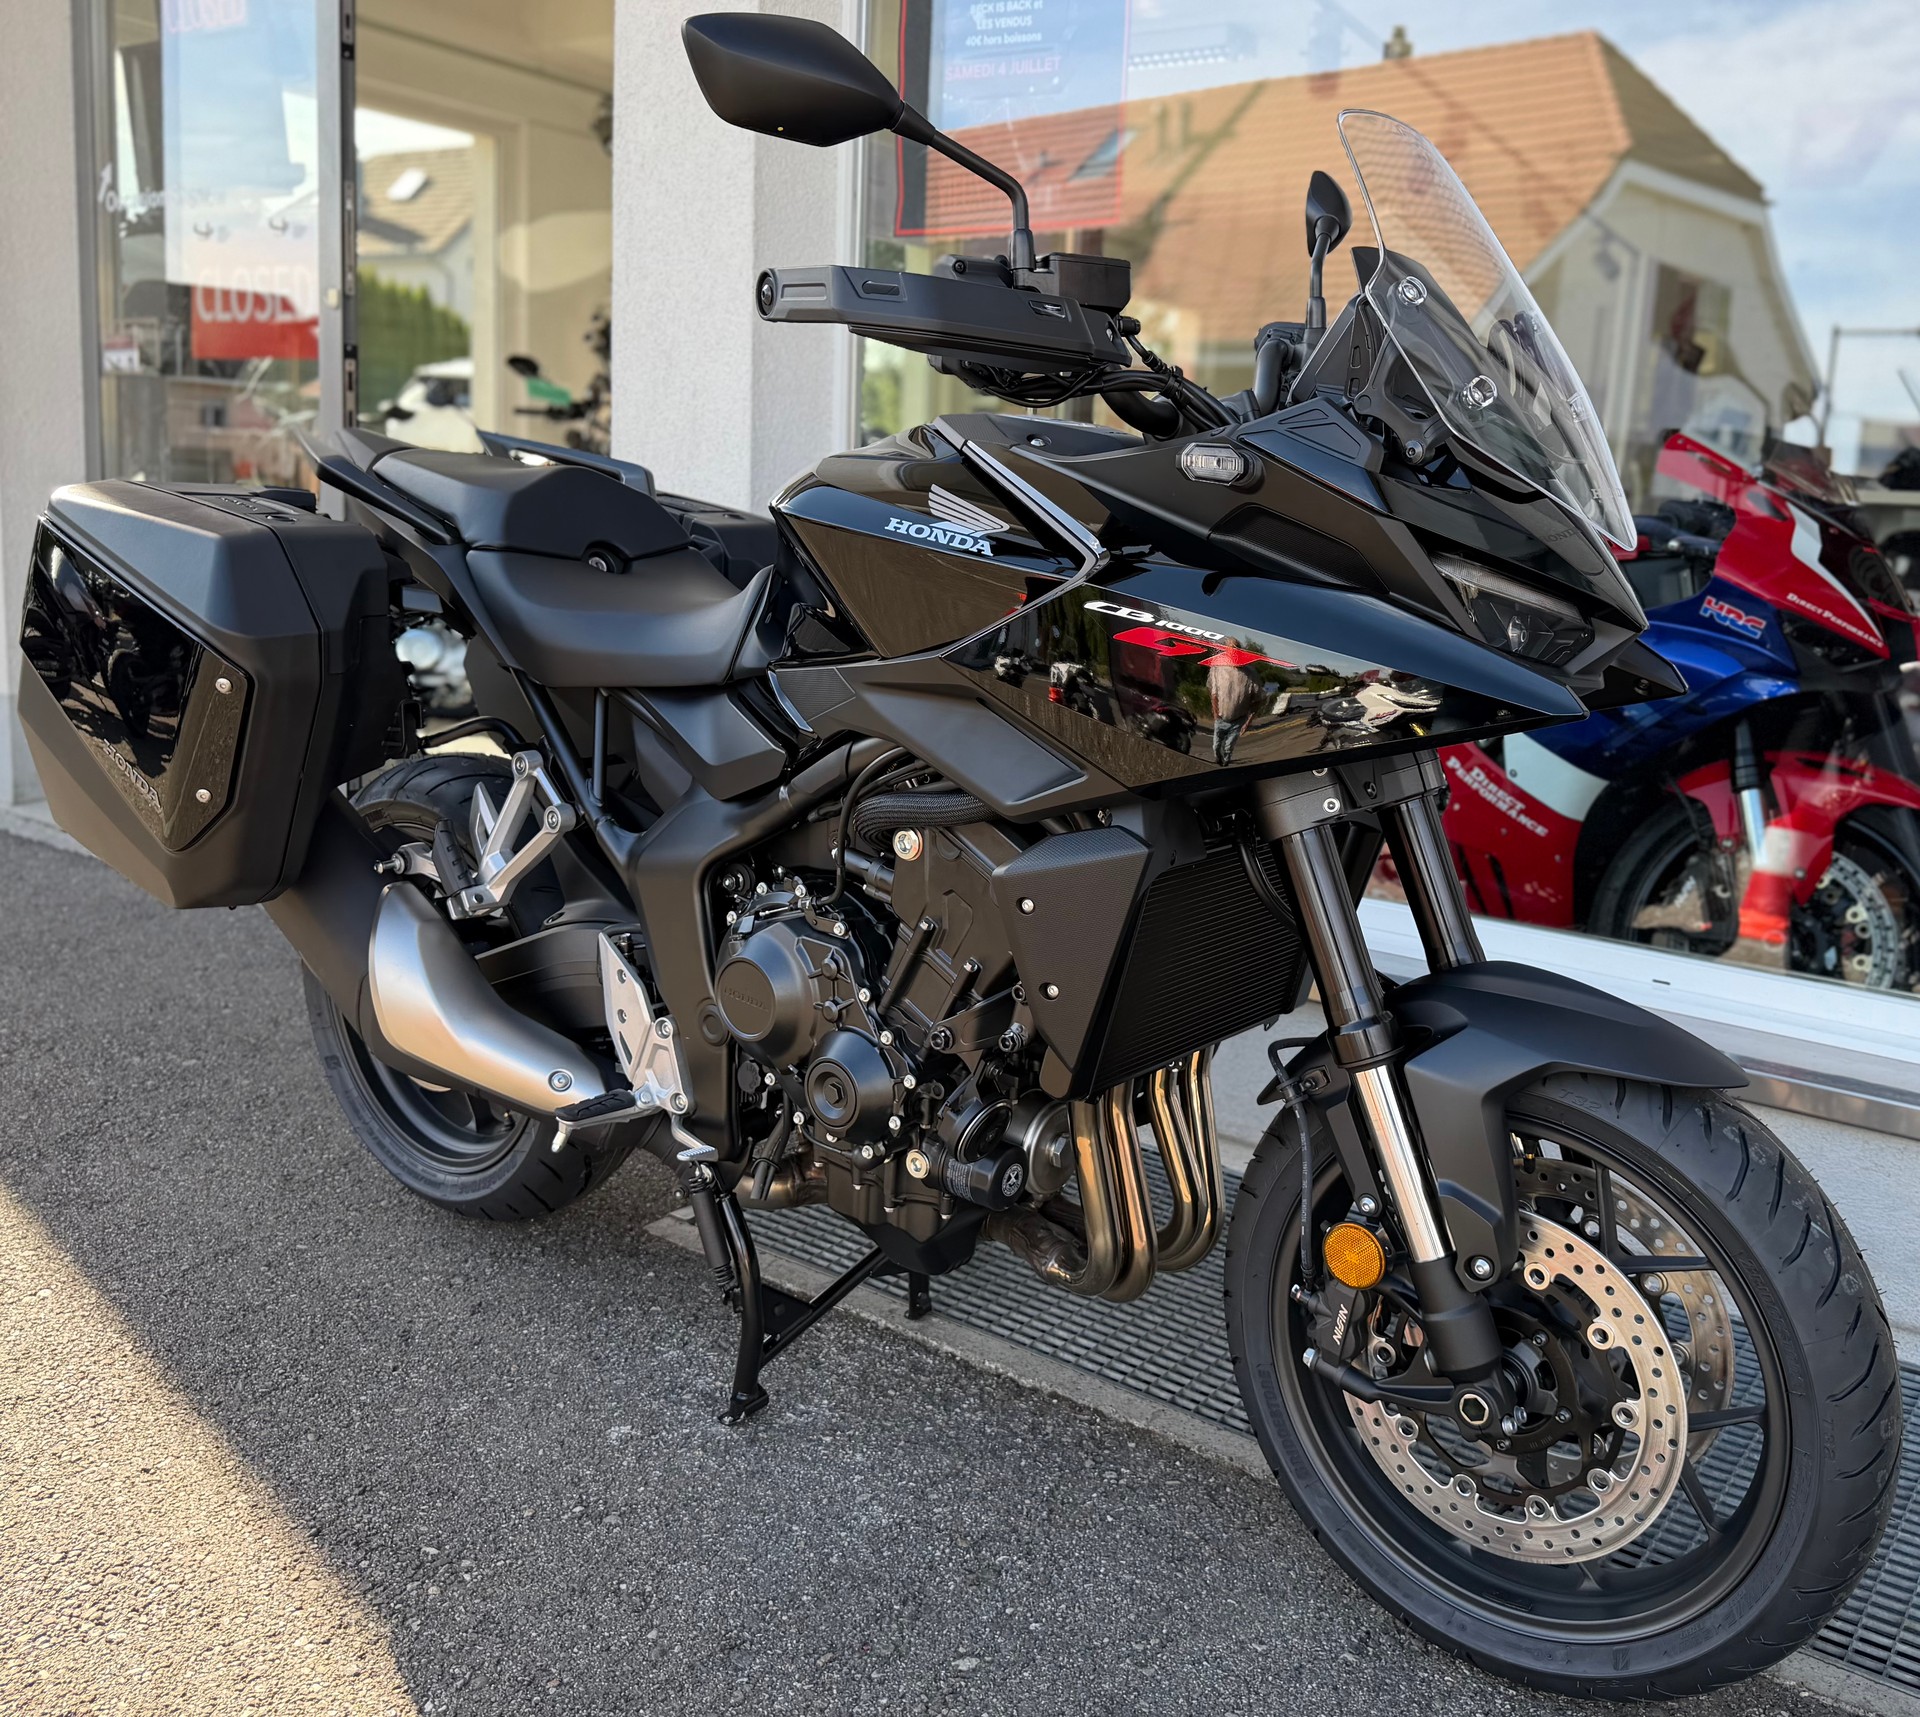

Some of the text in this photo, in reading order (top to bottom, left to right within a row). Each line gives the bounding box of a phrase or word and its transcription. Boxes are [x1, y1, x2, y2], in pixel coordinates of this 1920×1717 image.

[983, 34, 1002, 46] hors
[1004, 31, 1042, 44] boissons
[994, 15, 1032, 28] VENDUS
[945, 56, 1062, 82] SAMEDI 4 JUILLET
[196, 267, 312, 323] CLOSED
[884, 517, 994, 557] HONDA
[1084, 601, 1225, 641] CB 1000
[1700, 595, 1767, 640] HRC
[102, 738, 164, 816] HONDA
[1445, 755, 1549, 838] PERFORMANCE
[1470, 766, 1527, 811] DIRECT
